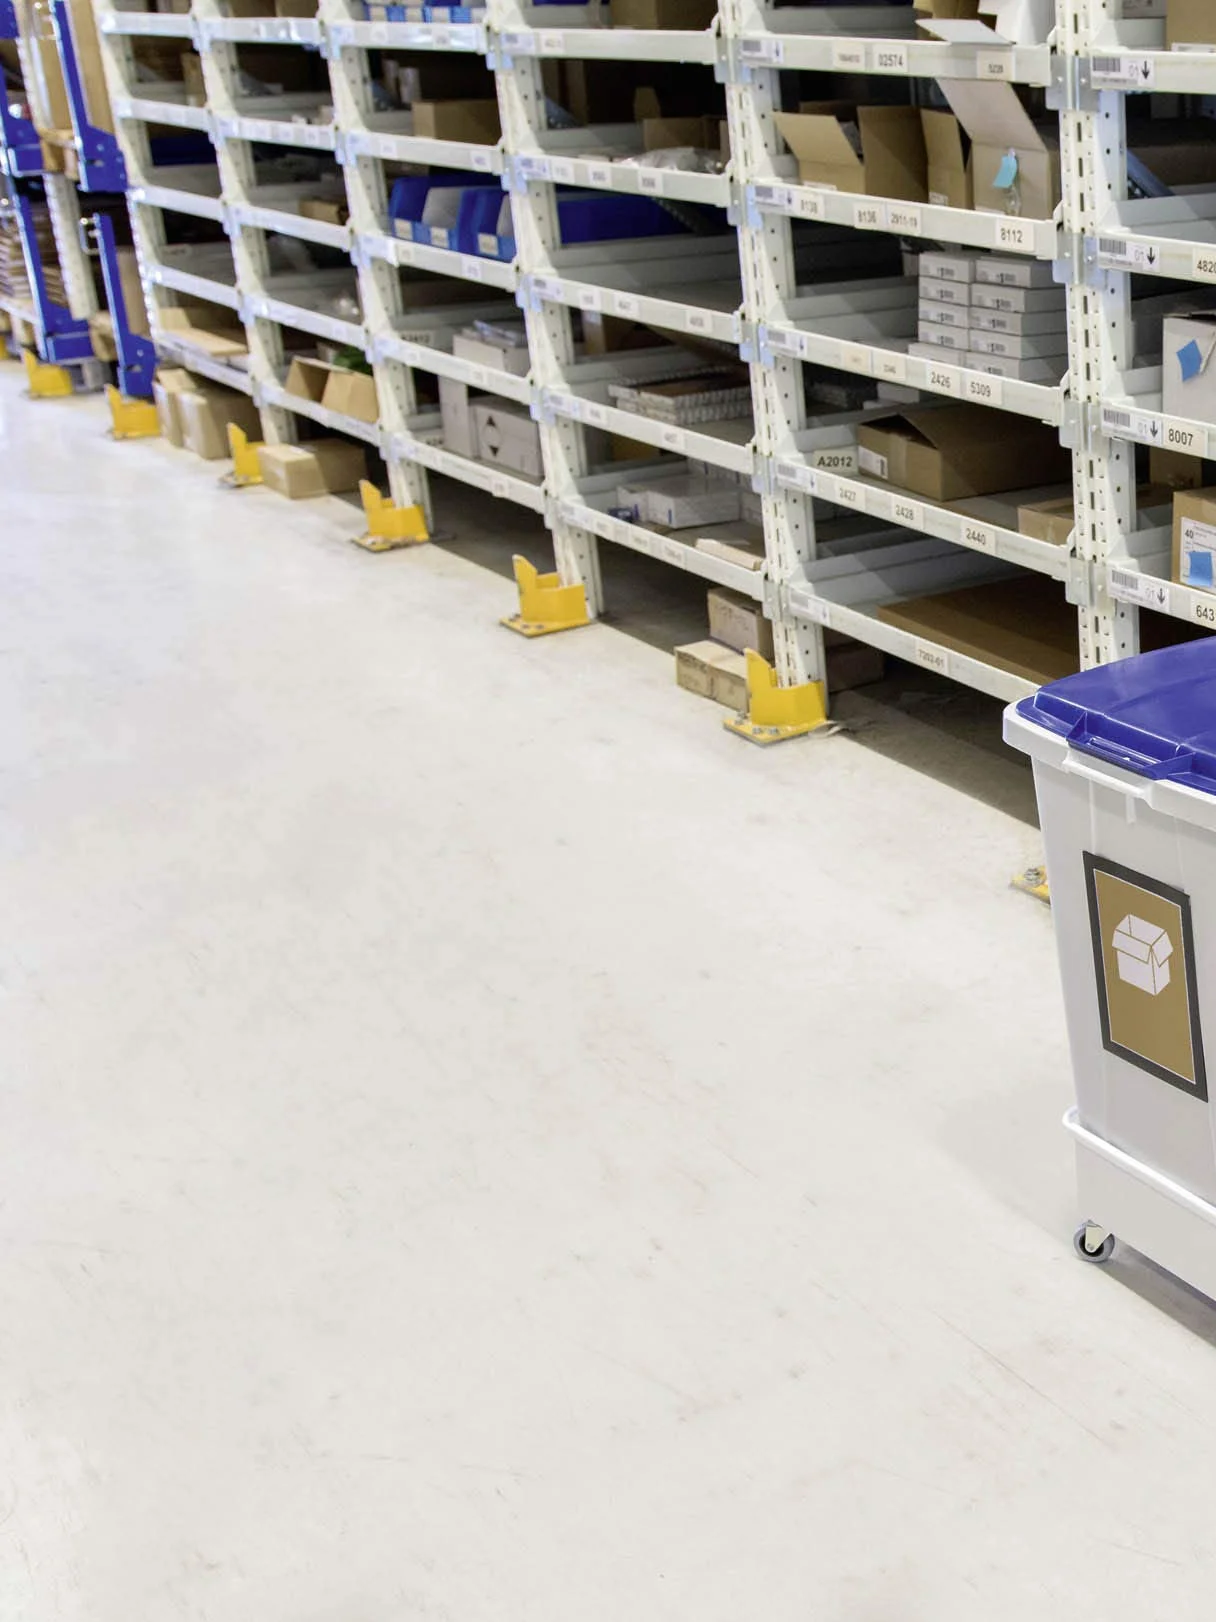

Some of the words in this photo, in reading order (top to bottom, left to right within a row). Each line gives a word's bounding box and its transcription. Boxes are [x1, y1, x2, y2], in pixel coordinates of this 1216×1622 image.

[1000, 228, 1023, 244] 8112
[1168, 428, 1194, 447] 8007
[817, 455, 853, 467] A2012
